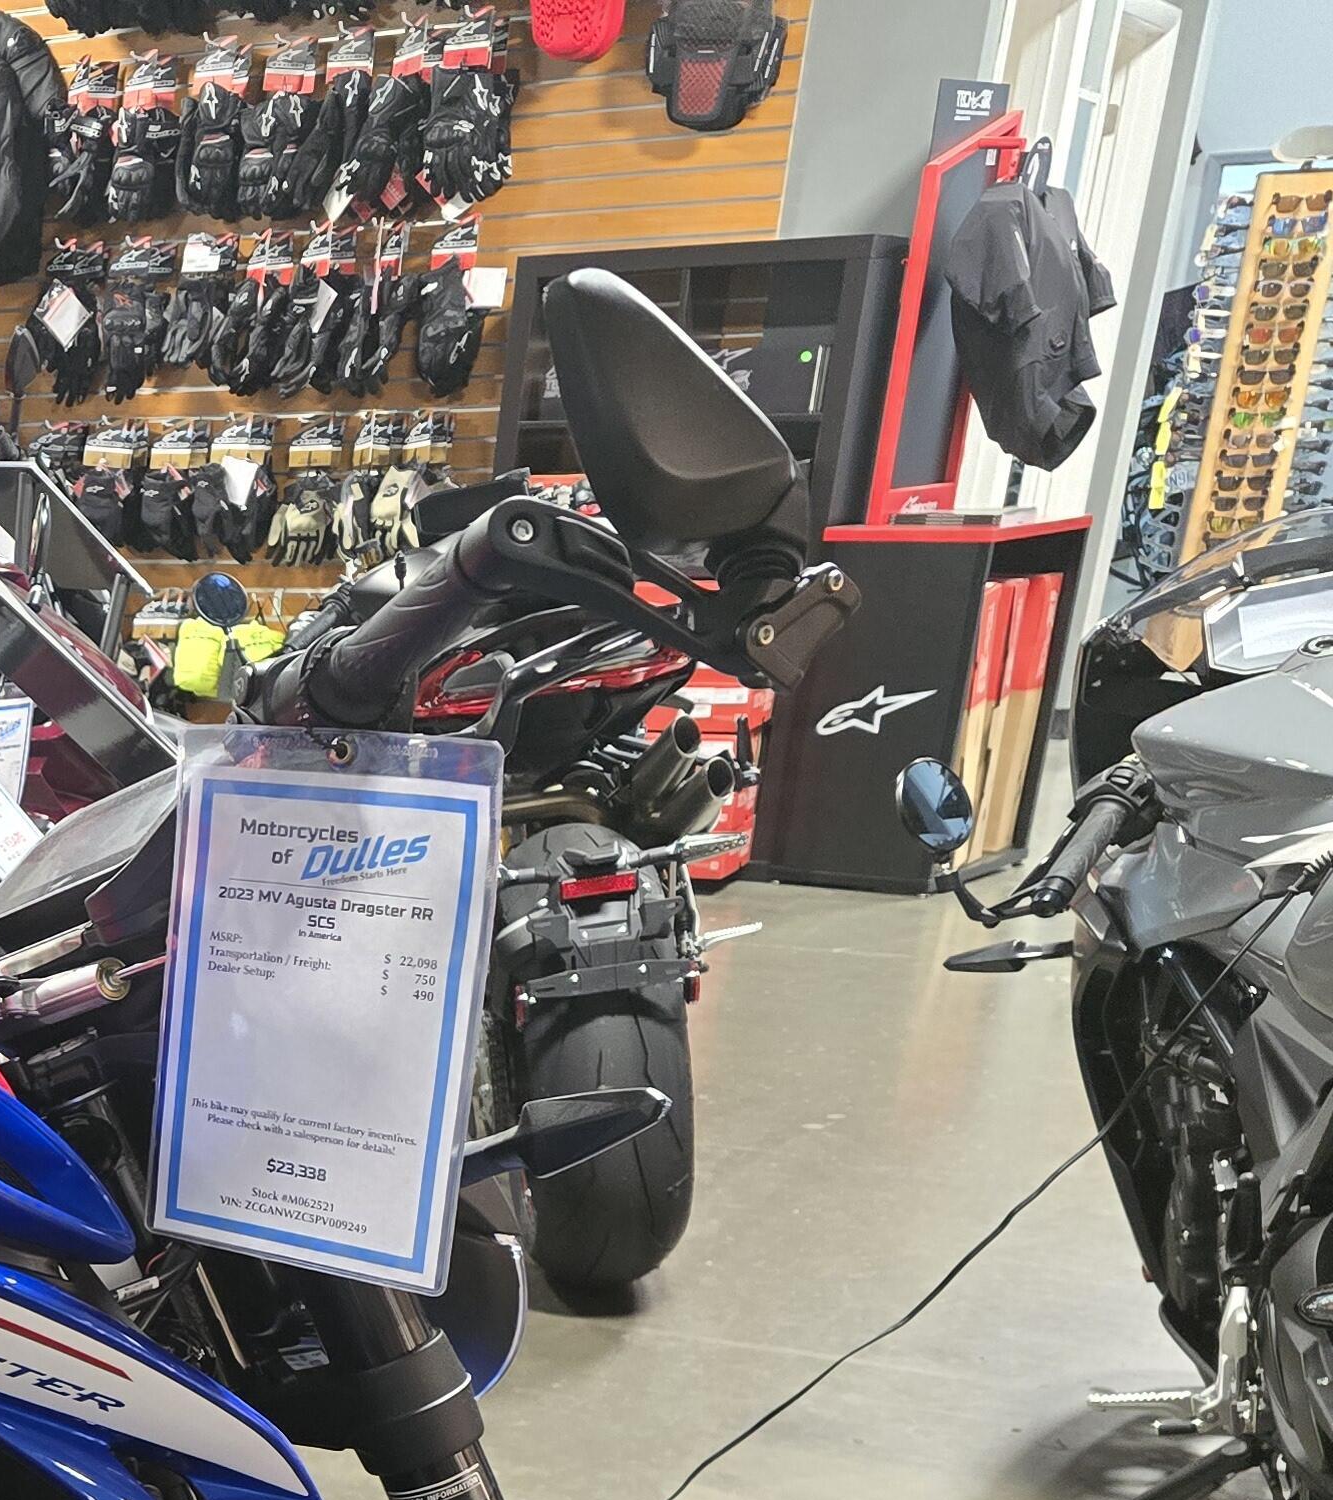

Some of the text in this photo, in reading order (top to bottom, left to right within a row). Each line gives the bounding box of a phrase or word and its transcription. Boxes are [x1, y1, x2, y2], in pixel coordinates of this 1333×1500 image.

[240, 818, 359, 844] Motorcycles
[271, 834, 431, 881] of Dulles
[322, 866, 408, 886] Freedom Starts Here
[218, 886, 434, 921] 2023 MV Agusta Dragster RR
[307, 915, 336, 929] SCS
[209, 931, 243, 944] MSRP:
[298, 929, 342, 942] In America
[209, 946, 283, 964] Transportation
[293, 956, 332, 971] Freight:
[384, 953, 438, 970] $ 22,098
[207, 961, 276, 980] Dealer Setup:
[382, 970, 436, 986] $ 750
[380, 985, 435, 1002] $ 490
[191, 1098, 418, 1146] This bike may qualify for current factory incentives.
[206, 1113, 234, 1126] Please
[236, 1119, 261, 1132] check
[263, 1123, 284, 1135] with
[284, 1128, 291, 1137] a
[292, 1129, 344, 1147] salesperson
[346, 1137, 361, 1149] for
[266, 1158, 327, 1183] $23,338
[219, 1195, 242, 1209] VIN:
[251, 1187, 335, 1213] Stock #M062521
